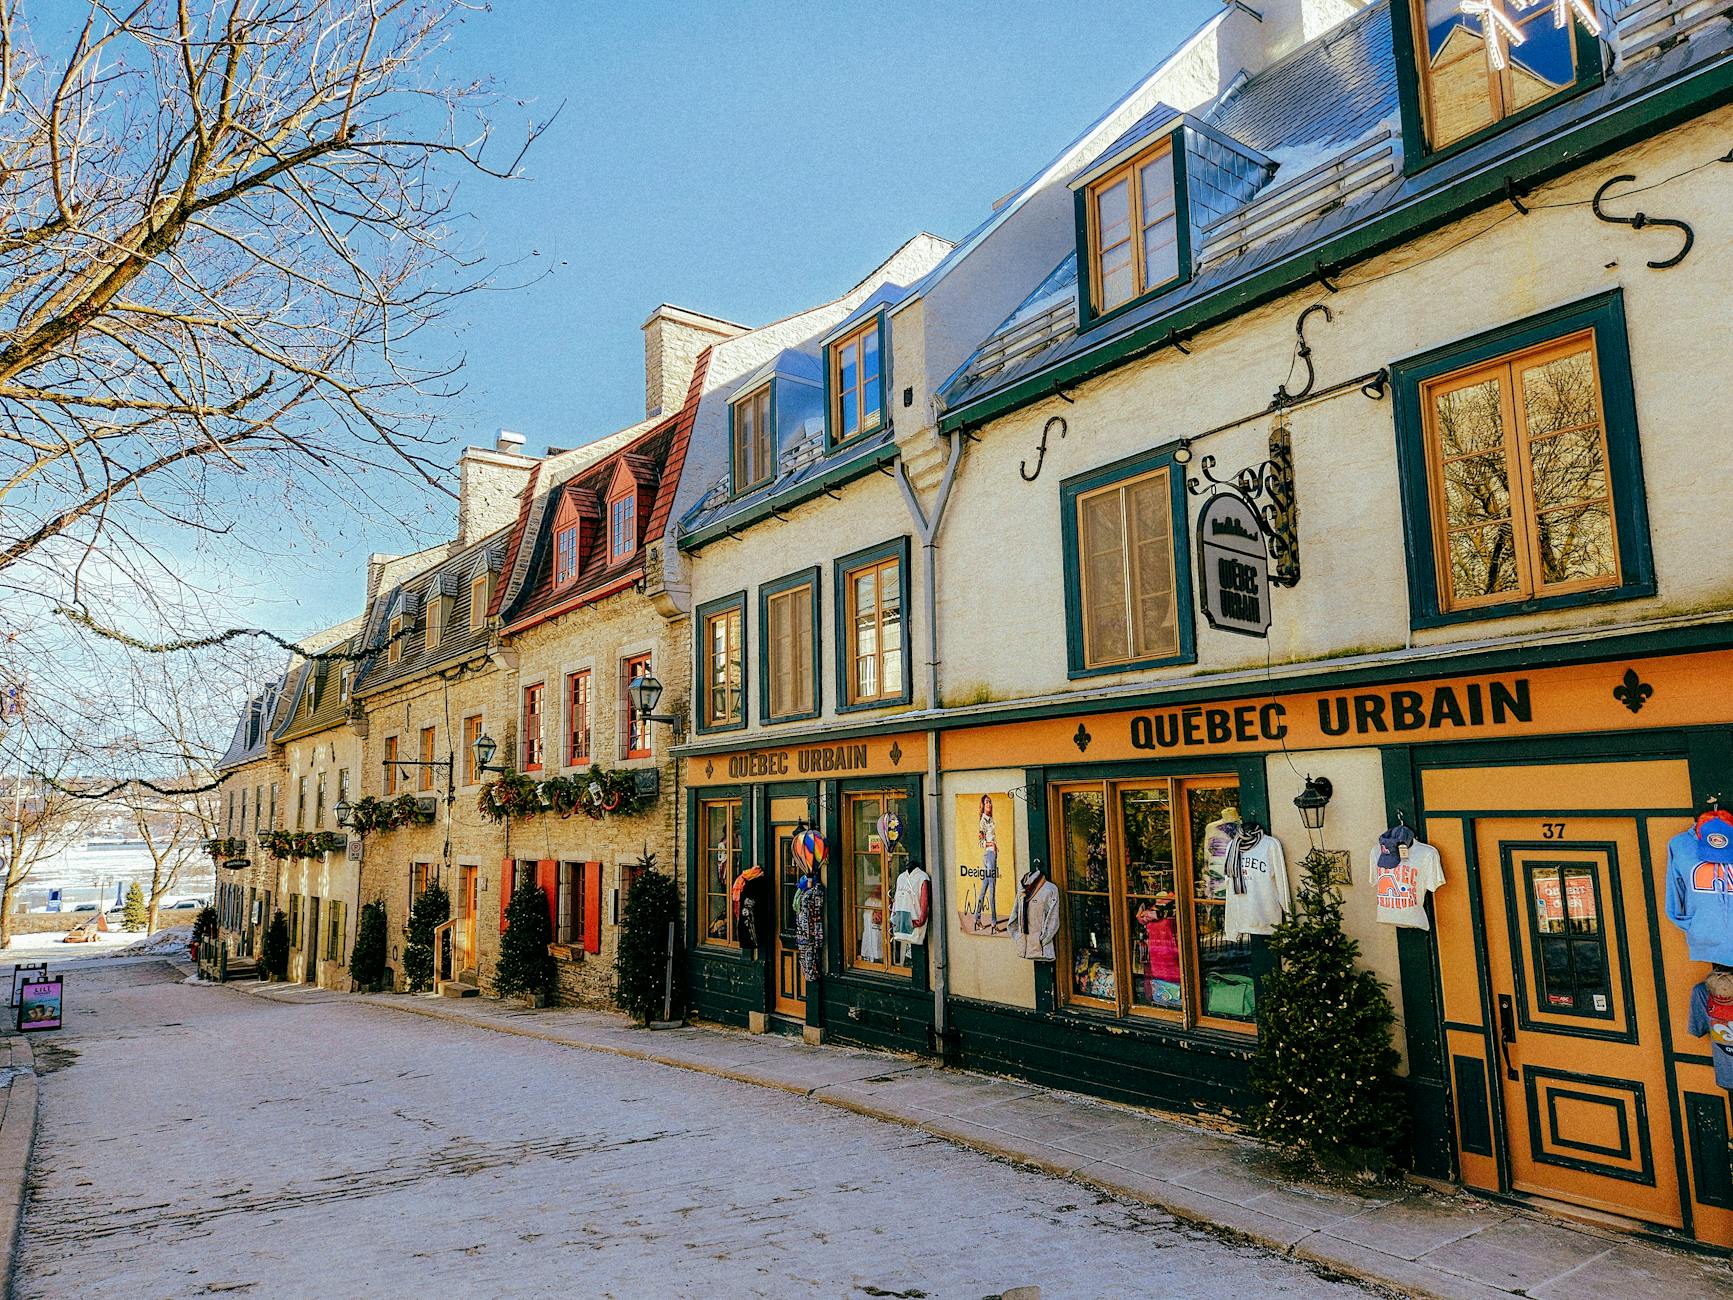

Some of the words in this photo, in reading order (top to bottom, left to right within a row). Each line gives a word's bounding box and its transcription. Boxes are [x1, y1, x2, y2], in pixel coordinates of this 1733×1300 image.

[1317, 678, 1533, 736] URBAIN
[798, 744, 868, 773] URBAIN
[1542, 823, 1566, 839] 37
[1552, 896, 1584, 909] OEN
